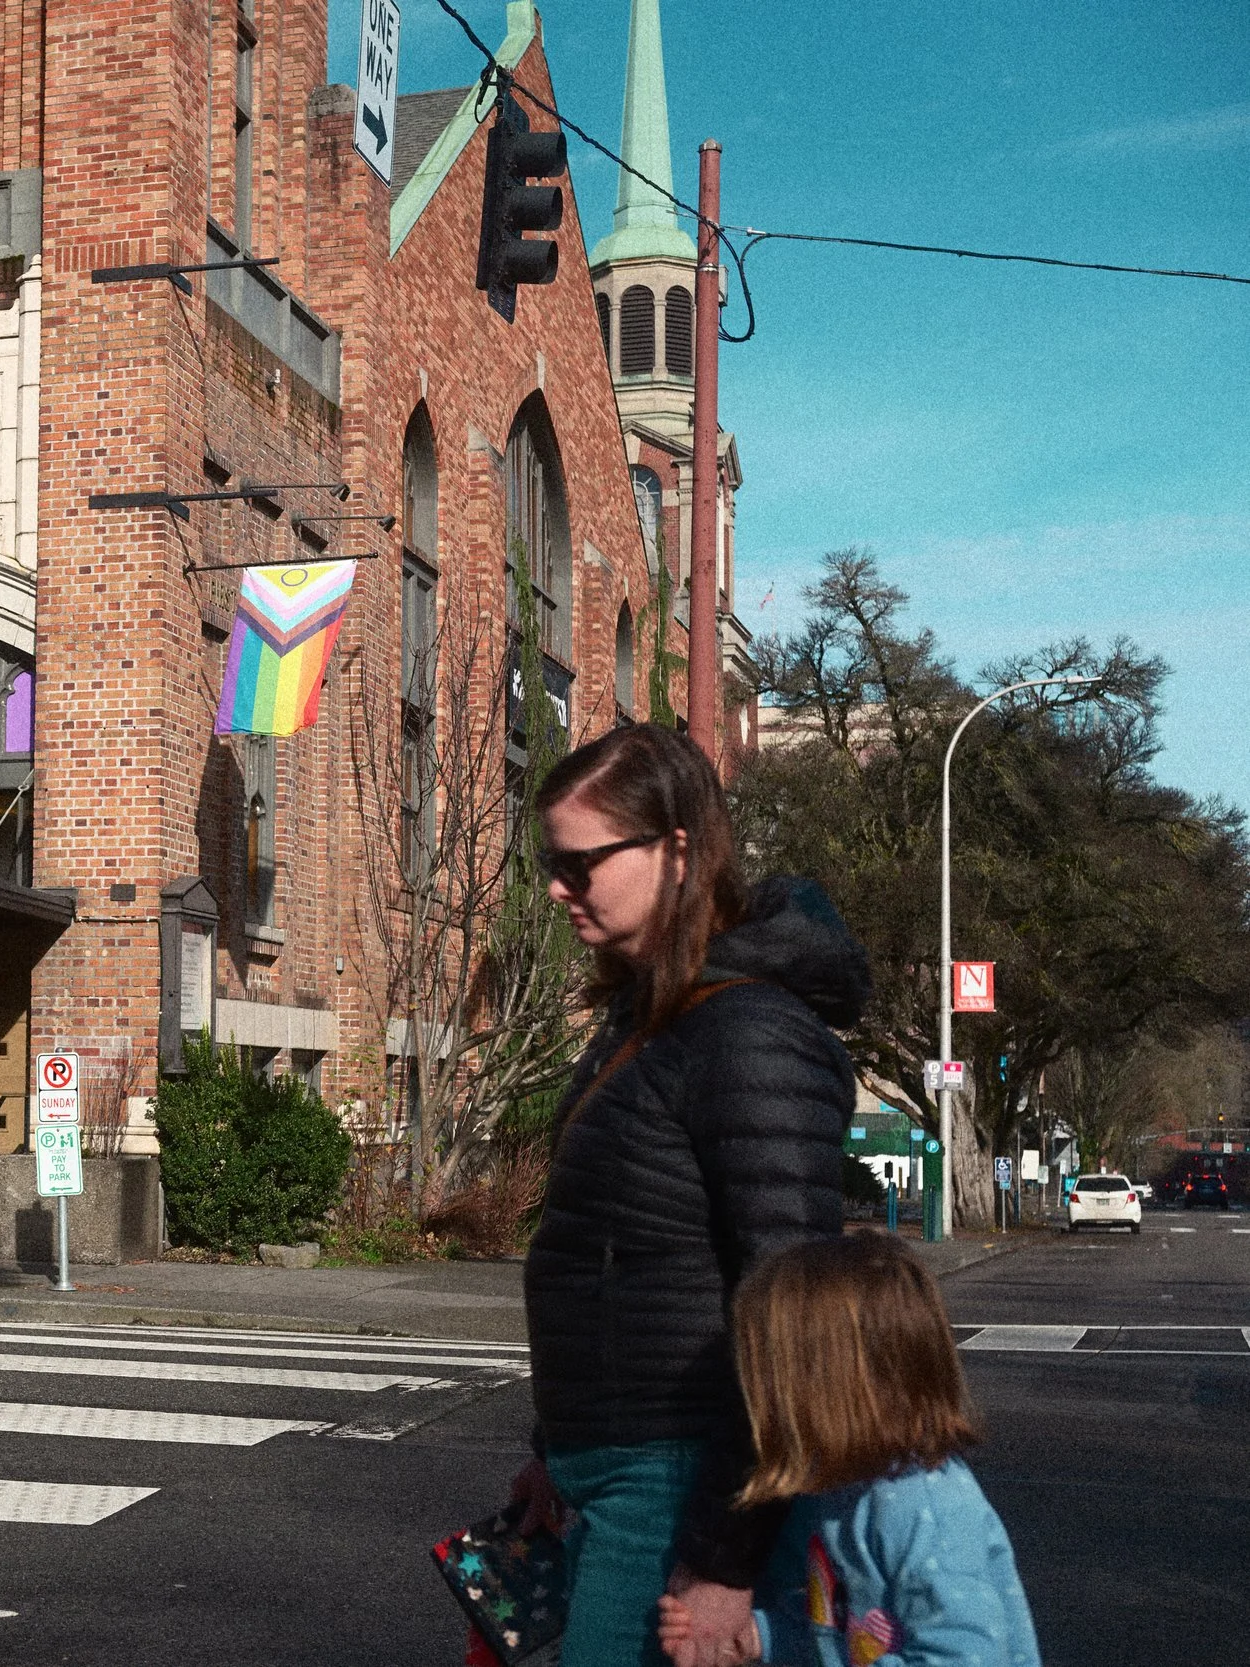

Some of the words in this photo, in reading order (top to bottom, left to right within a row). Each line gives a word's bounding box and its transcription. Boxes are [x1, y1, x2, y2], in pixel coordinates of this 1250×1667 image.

[369, 0, 395, 55] ONE
[366, 36, 393, 101] WAY
[962, 965, 985, 987] N
[41, 1097, 76, 1108] SUNDAY
[51, 1155, 67, 1163] PAY
[54, 1164, 66, 1172] TO
[49, 1172, 71, 1181] PARK
